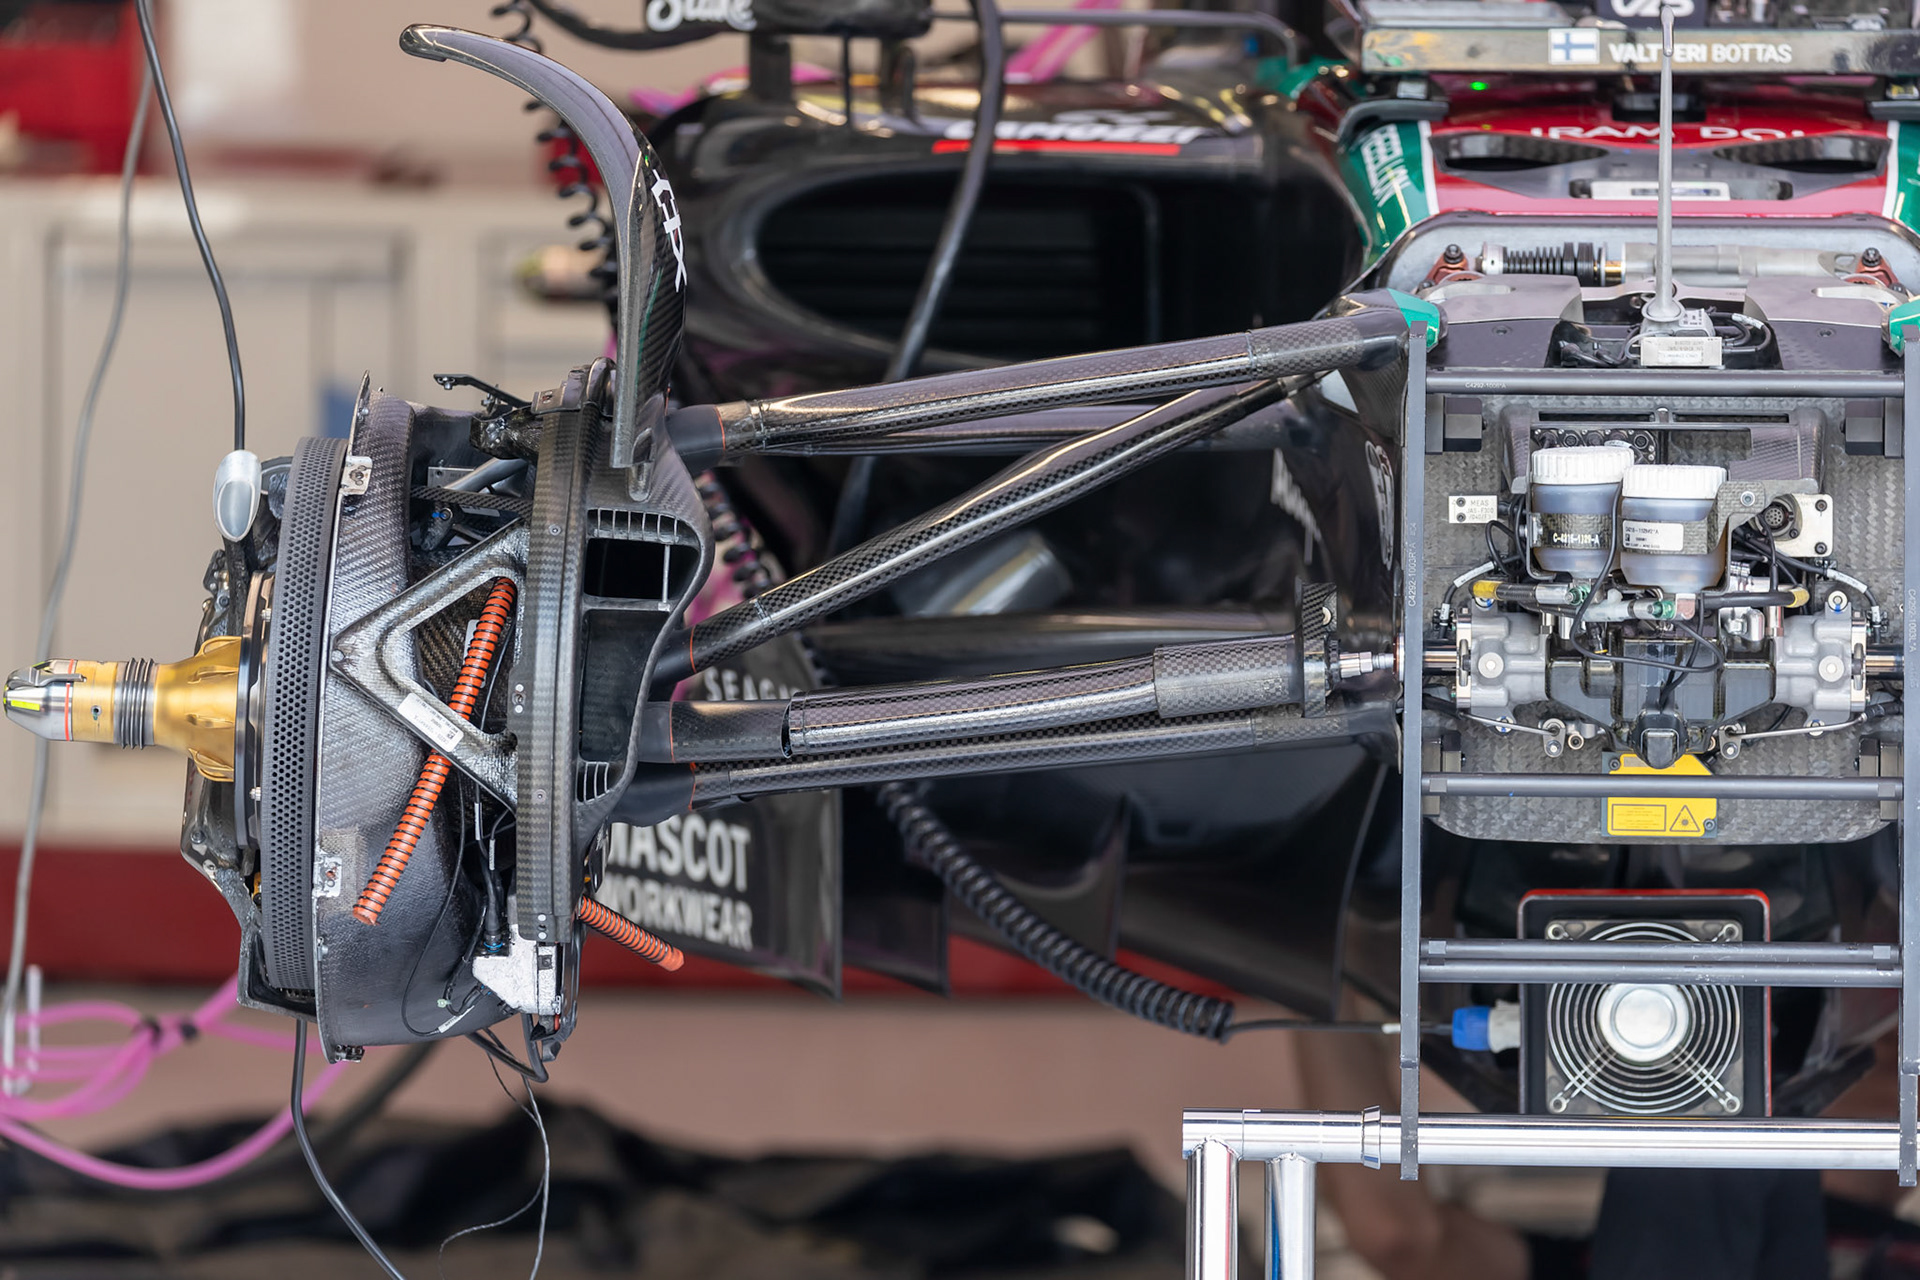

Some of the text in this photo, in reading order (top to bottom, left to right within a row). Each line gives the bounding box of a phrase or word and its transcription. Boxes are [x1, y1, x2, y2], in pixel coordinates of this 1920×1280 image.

[1608, 43, 1793, 63] VALTERI BOTTAS
[608, 813, 752, 893] MASCOT
[600, 872, 754, 952] WORKWEAR
